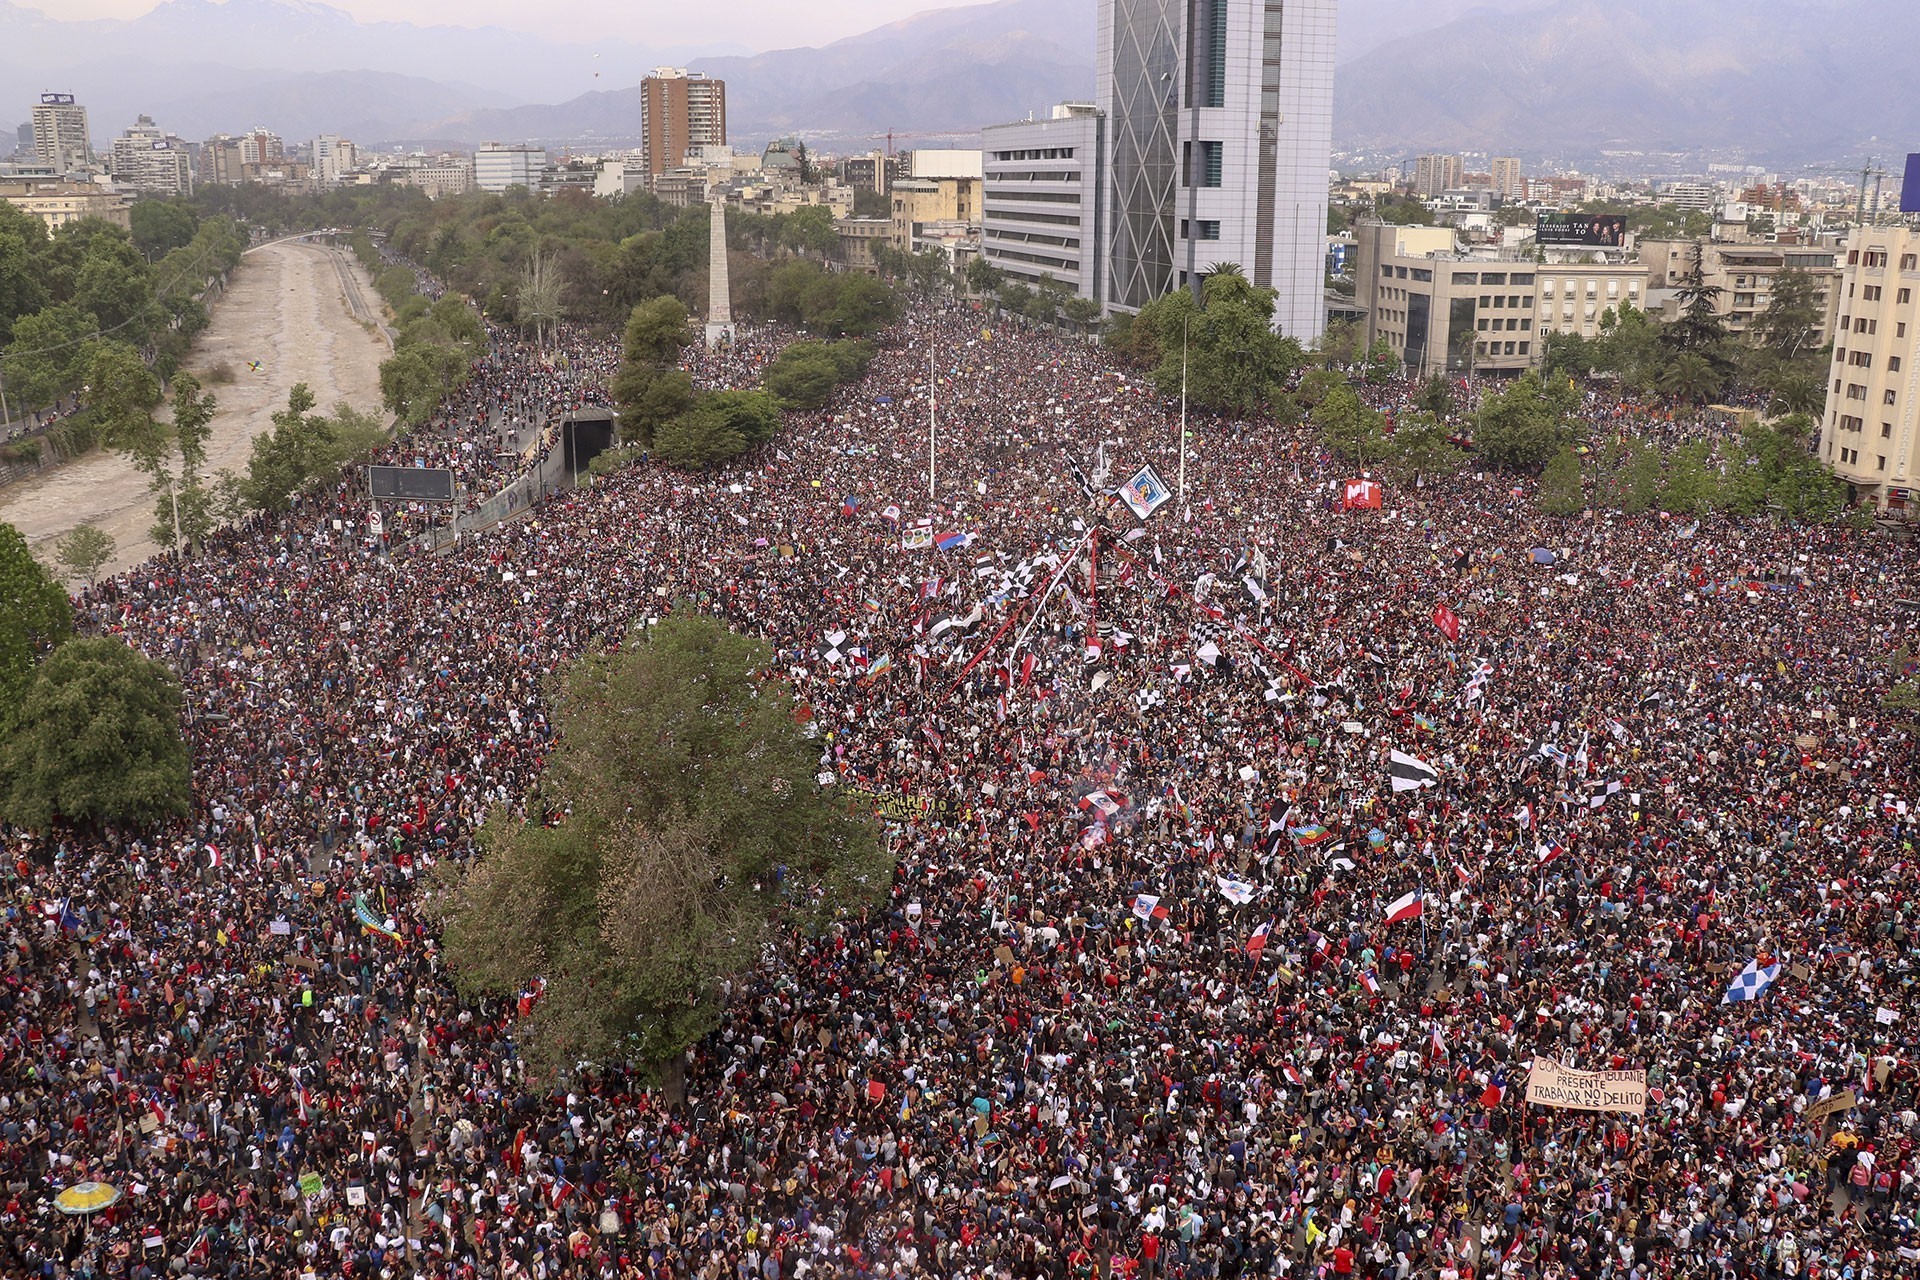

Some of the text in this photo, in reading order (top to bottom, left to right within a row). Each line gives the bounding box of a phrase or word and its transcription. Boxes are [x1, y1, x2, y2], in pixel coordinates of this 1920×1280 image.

[1557, 1075, 1606, 1089] PRESENTE
[1585, 1089, 1601, 1099] NO
[1585, 1099, 1600, 1107] ES
